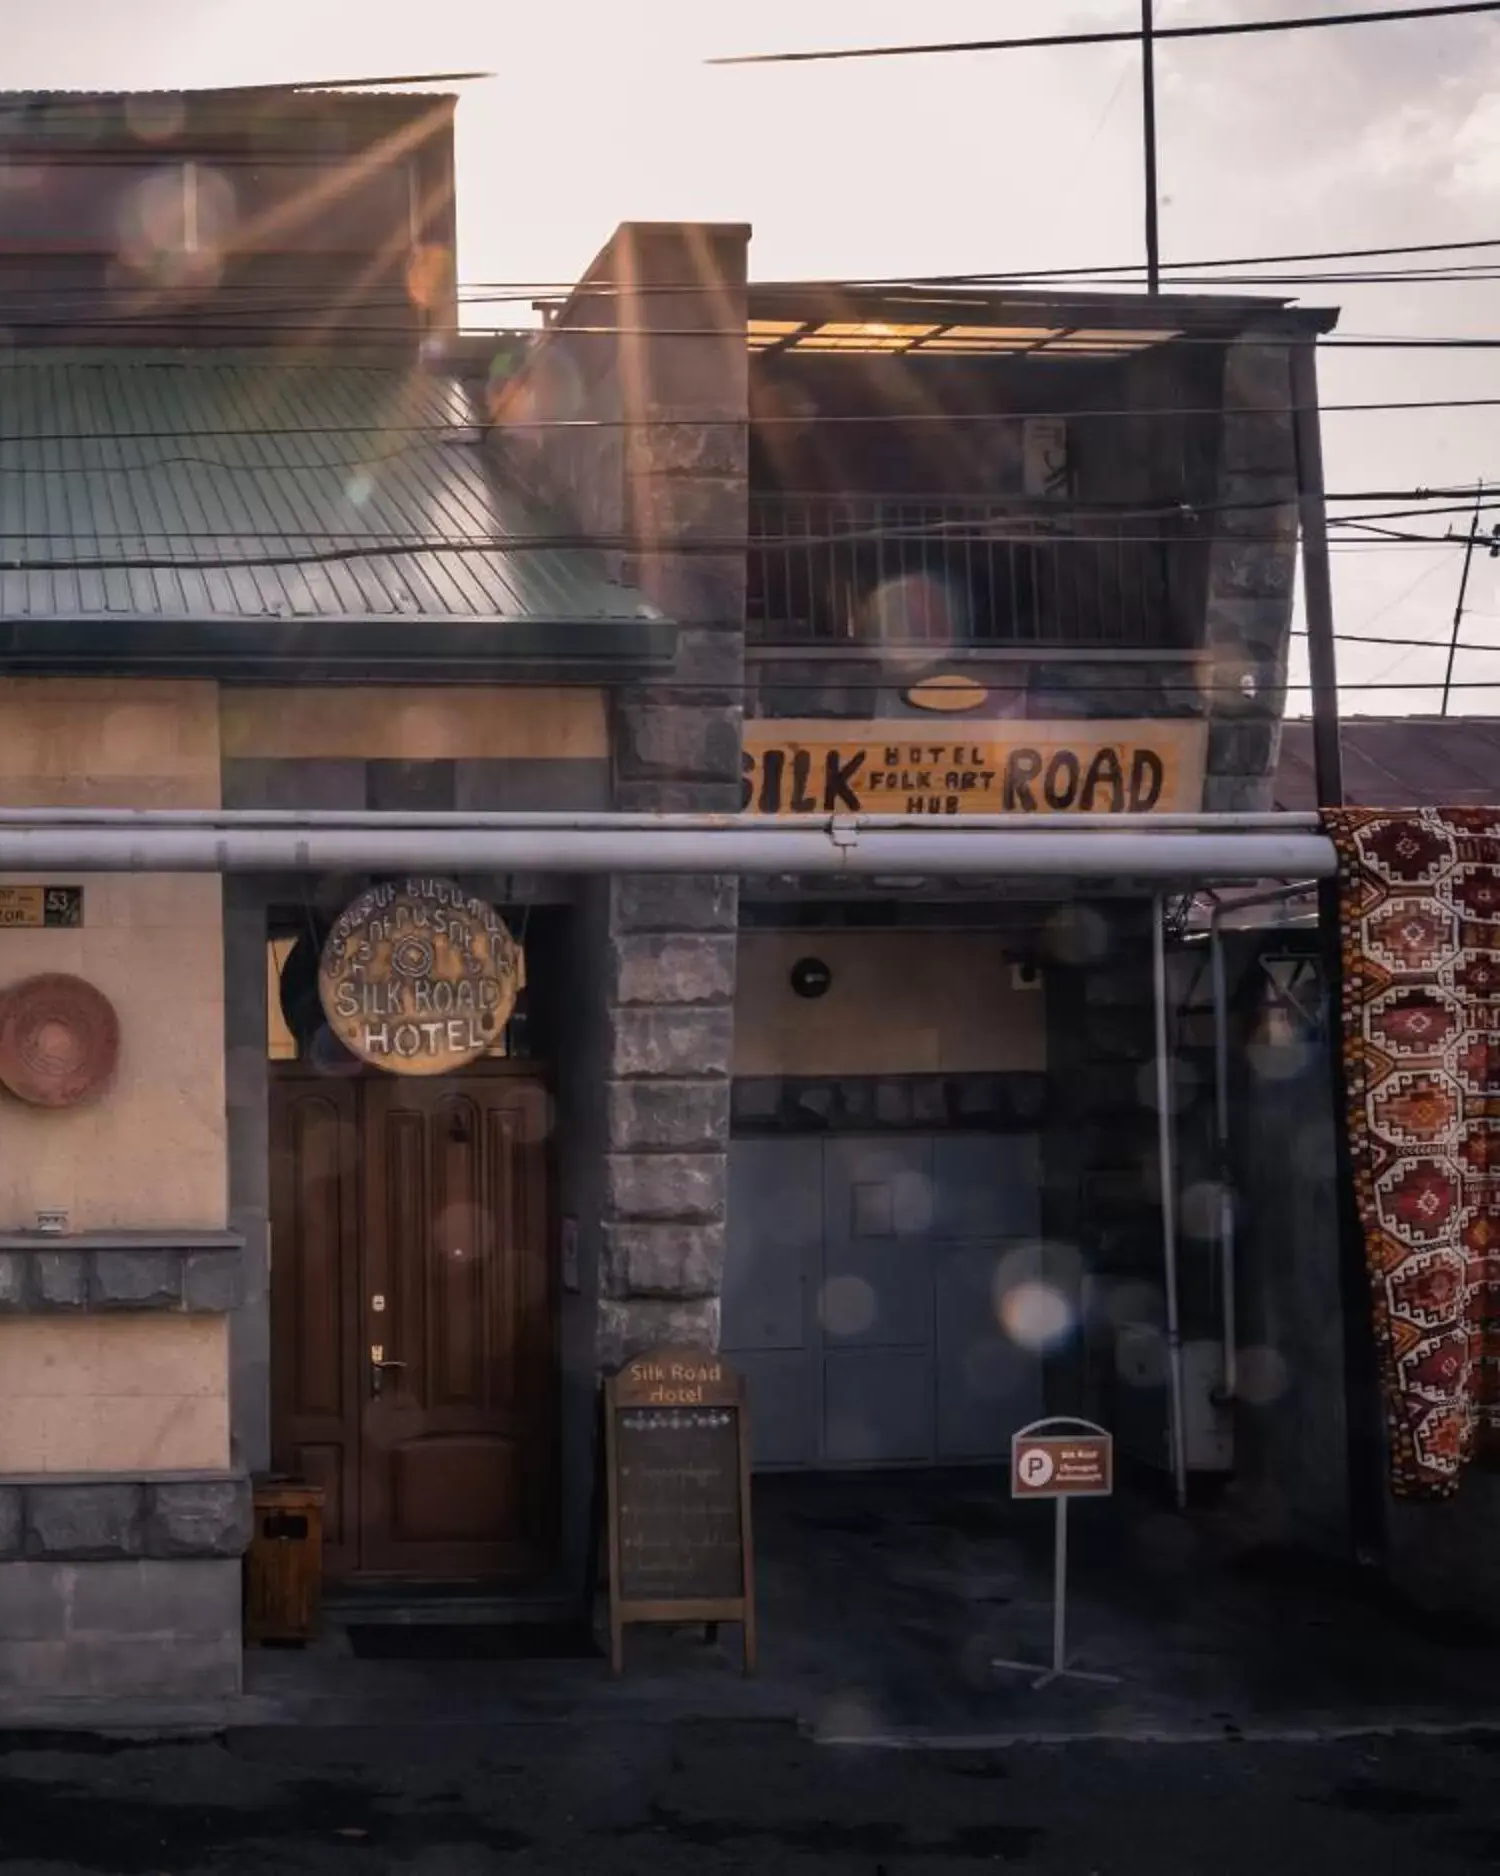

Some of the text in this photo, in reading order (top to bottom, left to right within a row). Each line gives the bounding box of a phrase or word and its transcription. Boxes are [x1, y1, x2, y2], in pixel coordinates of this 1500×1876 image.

[885, 747, 984, 766] HOTEL
[869, 771, 997, 790] FOLK ART
[1003, 748, 1163, 813] ROAD
[906, 796, 959, 814] HUB
[336, 975, 500, 1017] SILK ROAD
[364, 1019, 485, 1056] HOTEL
[630, 1362, 721, 1381] Silk Road
[650, 1384, 702, 1402] Hotel
[1028, 1457, 1044, 1479] P
